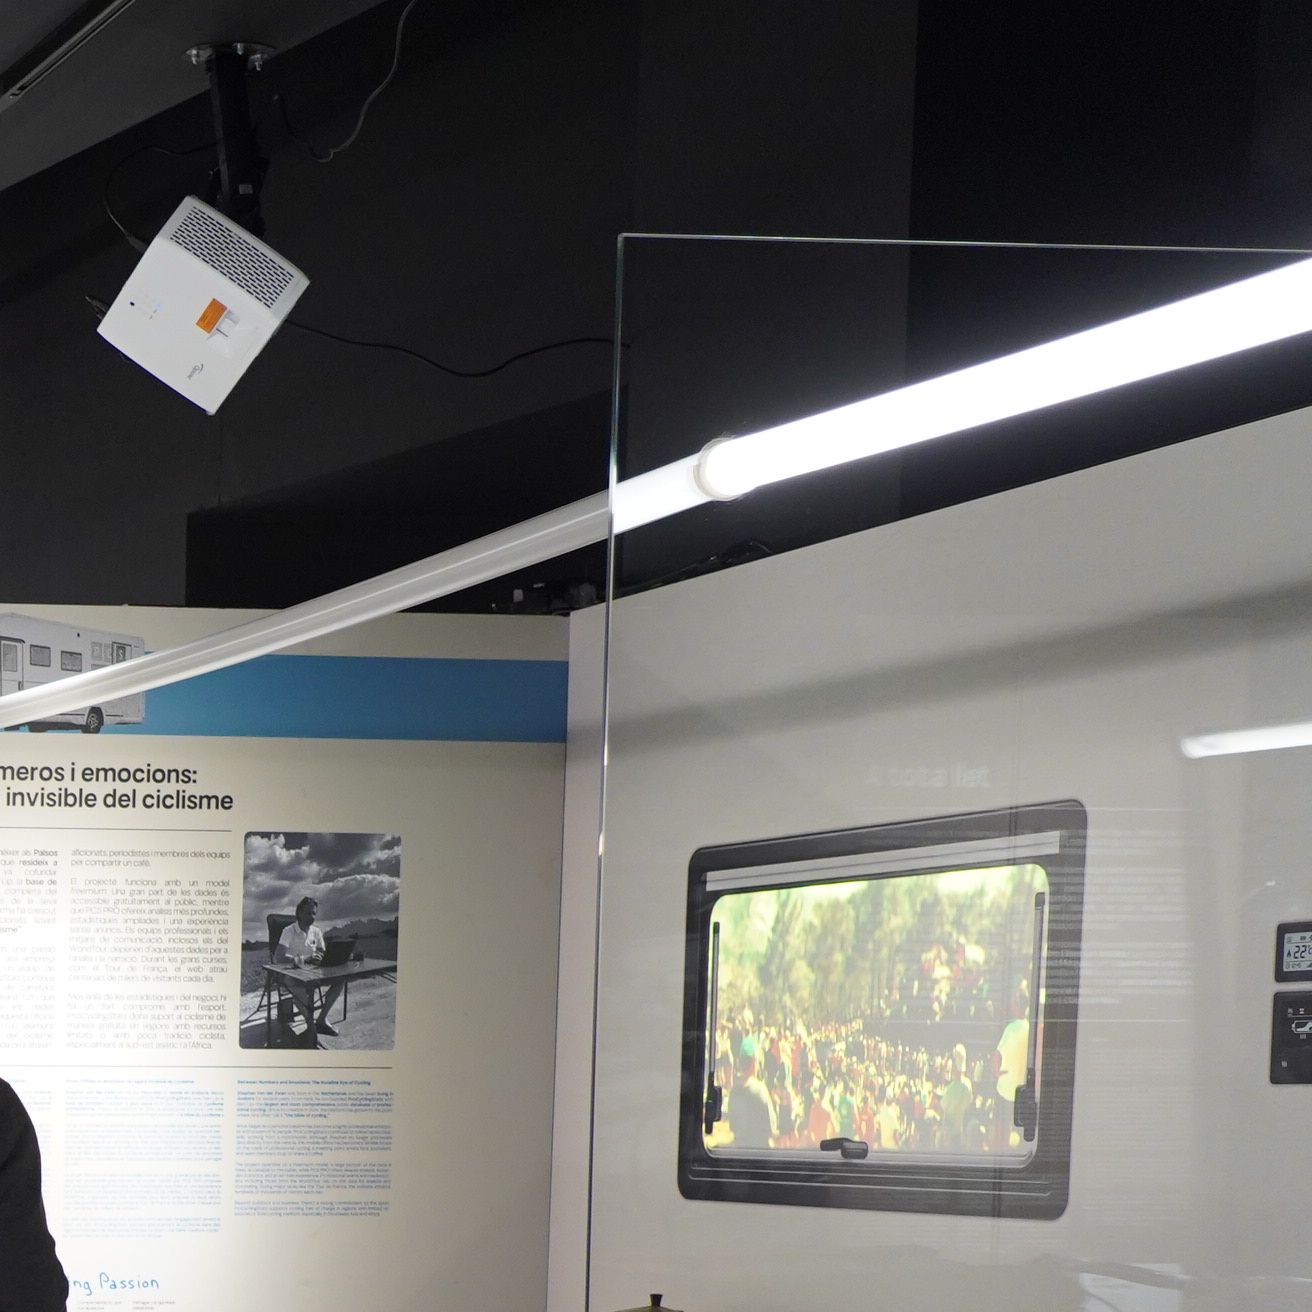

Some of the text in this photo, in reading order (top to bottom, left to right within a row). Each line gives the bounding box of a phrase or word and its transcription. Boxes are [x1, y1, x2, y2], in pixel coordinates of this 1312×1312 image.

[70, 763, 76, 782] i
[81, 764, 198, 784] emocions:
[6, 787, 98, 808] invisible
[103, 789, 136, 809] del
[142, 790, 234, 810] ciclisme
[99, 1271, 160, 1289] Passion
